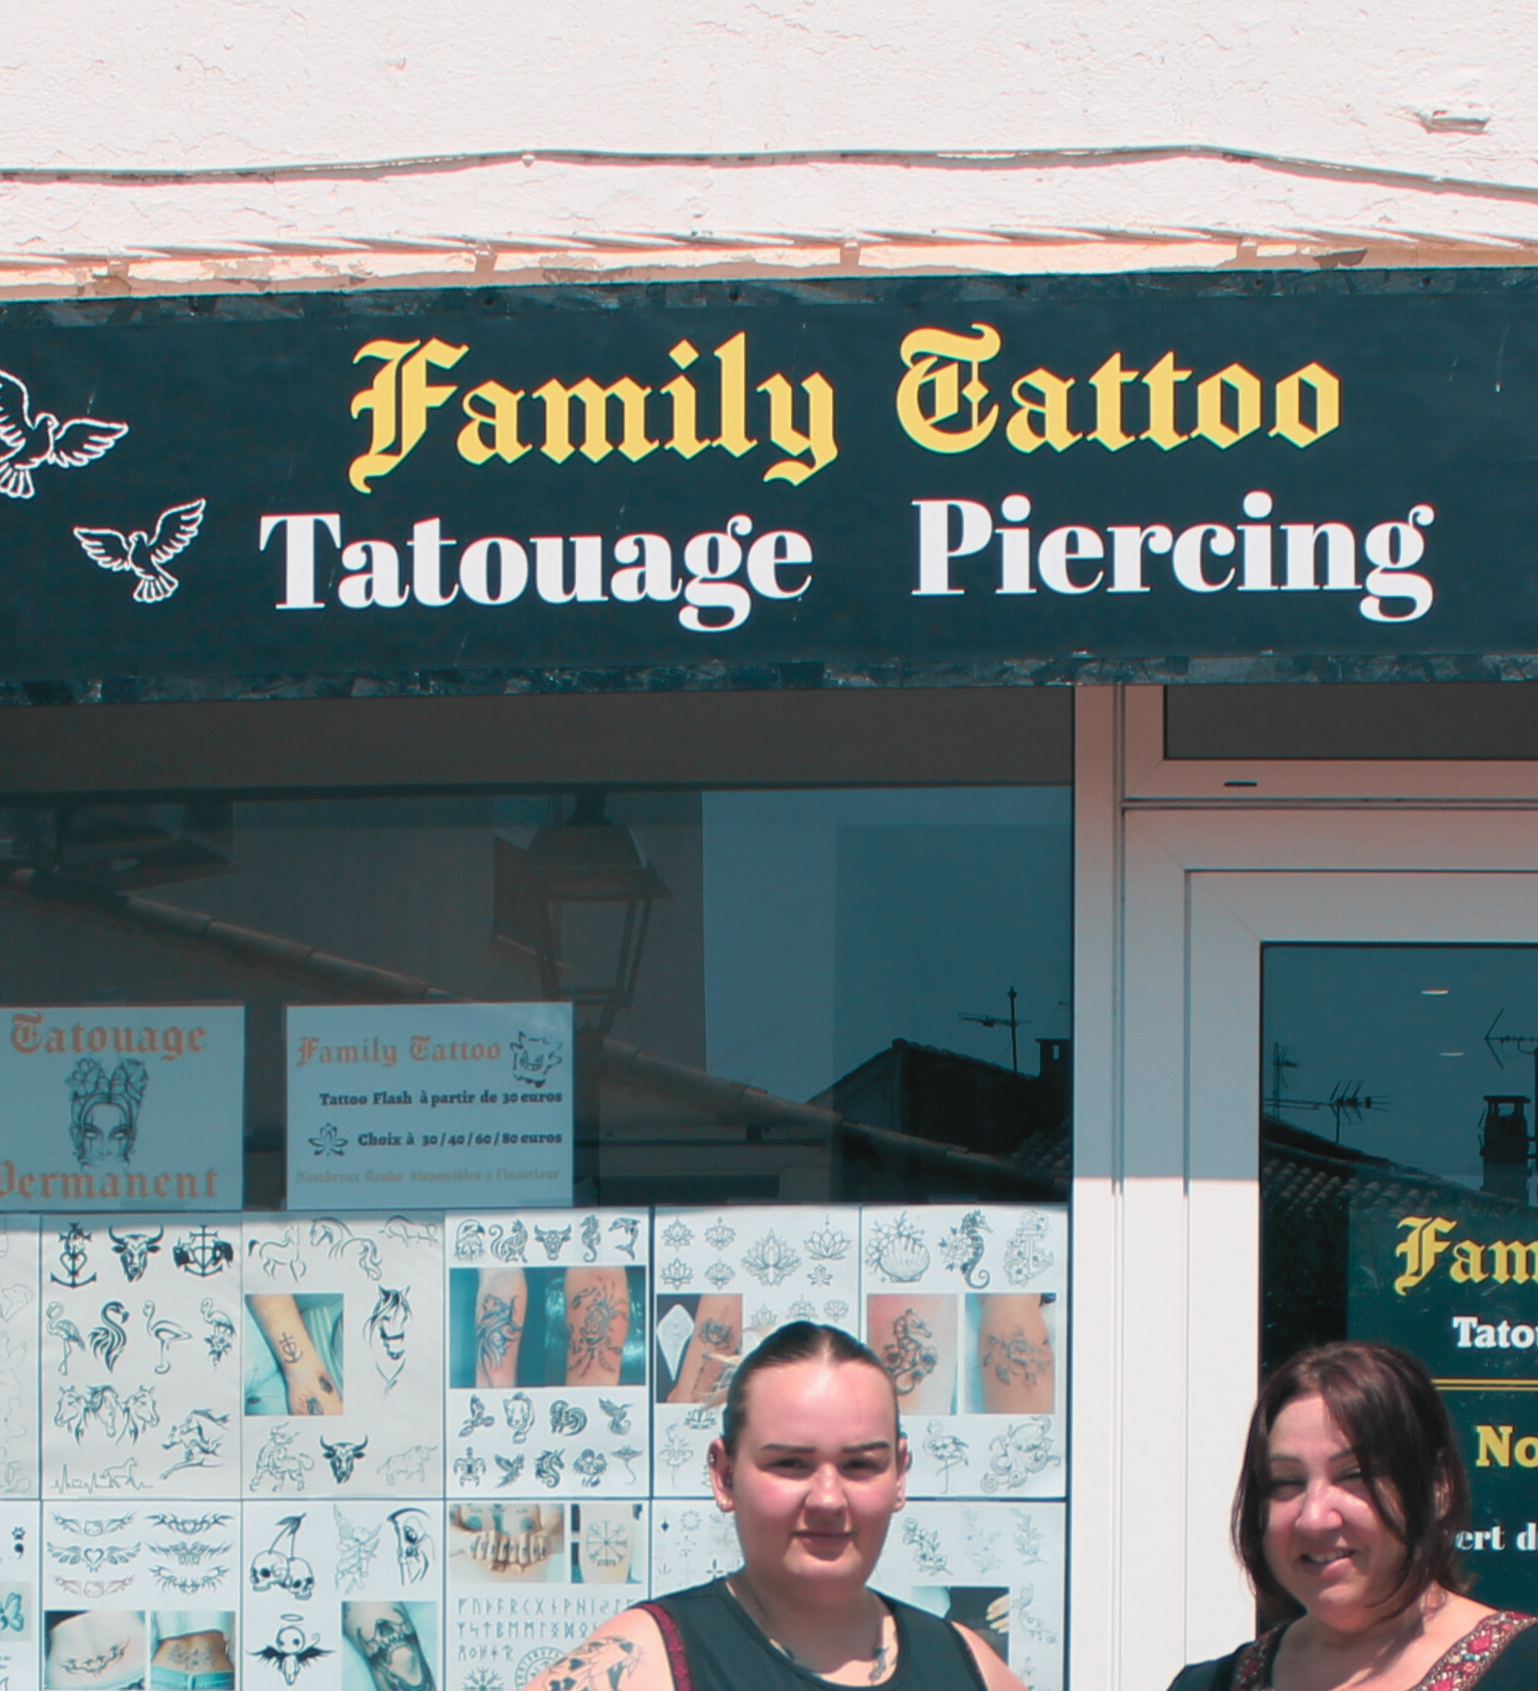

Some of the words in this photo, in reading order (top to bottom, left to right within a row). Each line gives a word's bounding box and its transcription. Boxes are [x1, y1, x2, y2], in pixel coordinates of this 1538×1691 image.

[349, 334, 840, 493] Family
[895, 324, 1342, 460] Tattoo
[259, 510, 813, 634] Tatouage
[912, 493, 1435, 623] Piercing
[10, 1014, 207, 1061] Tatouage
[297, 1036, 398, 1067] Family
[409, 1035, 500, 1062] Tattoo
[320, 1093, 367, 1105] Tattoo
[373, 1091, 412, 1105] Flash
[420, 1091, 428, 1104] à
[431, 1091, 475, 1107] partir
[481, 1090, 497, 1104] de
[503, 1093, 518, 1105] 30
[521, 1091, 562, 1103] euros
